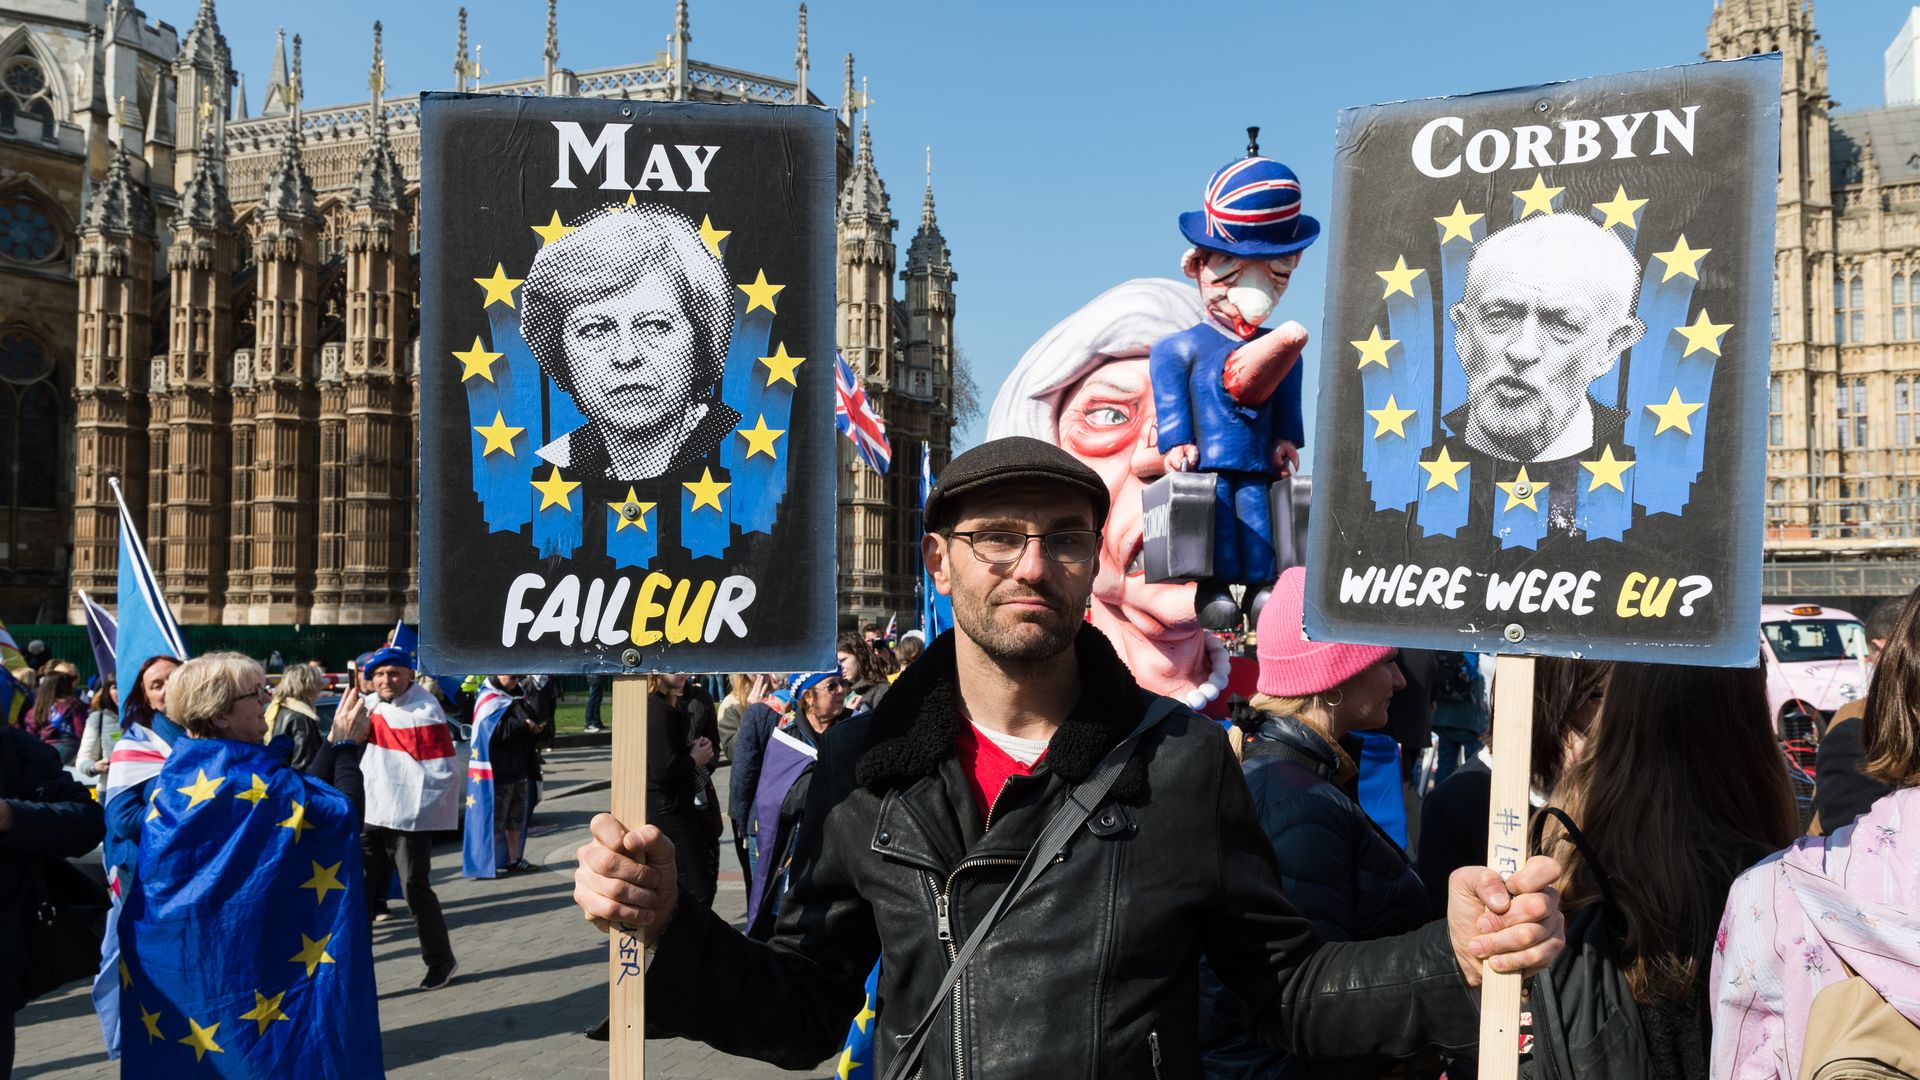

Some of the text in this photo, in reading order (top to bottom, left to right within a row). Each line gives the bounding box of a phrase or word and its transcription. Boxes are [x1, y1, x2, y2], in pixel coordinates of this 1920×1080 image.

[550, 120, 722, 193] MAY
[1411, 105, 1702, 179] CORBYN
[501, 571, 757, 648] FAILEUR
[1339, 564, 1713, 619] WHERE WERE EU?
